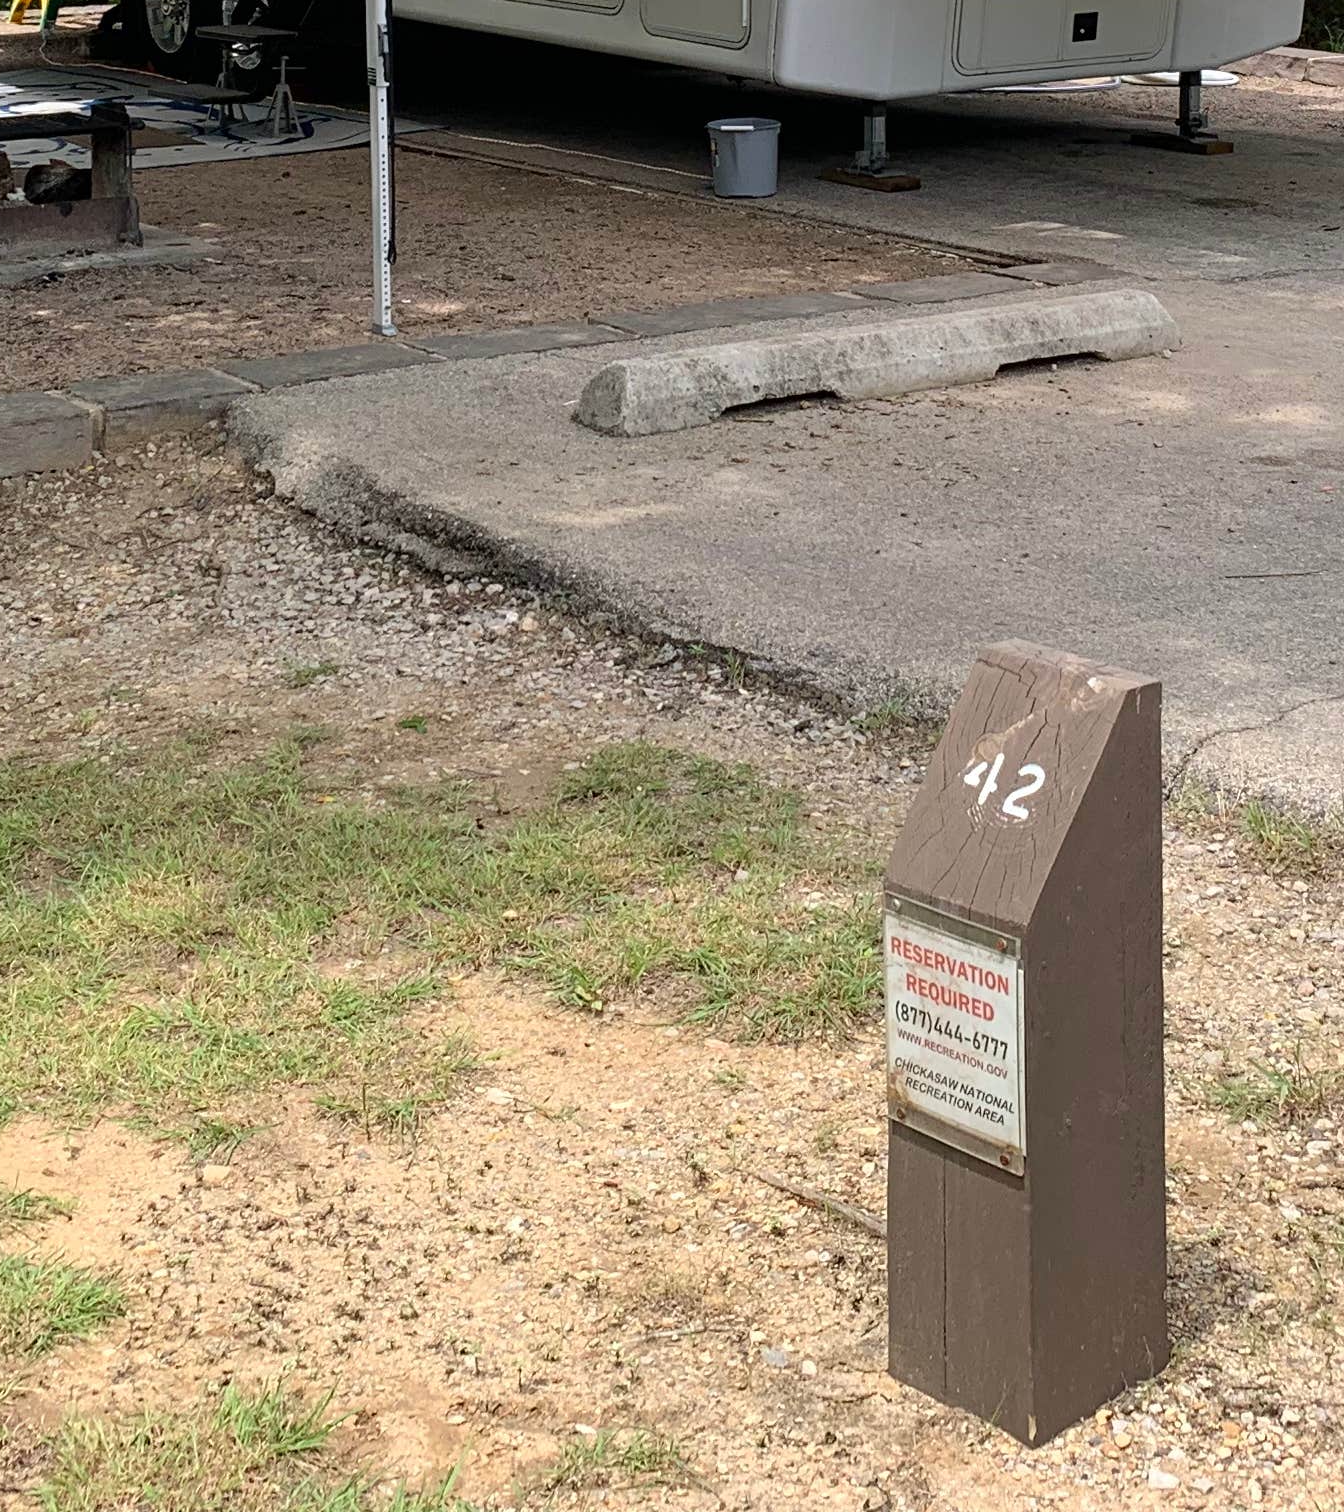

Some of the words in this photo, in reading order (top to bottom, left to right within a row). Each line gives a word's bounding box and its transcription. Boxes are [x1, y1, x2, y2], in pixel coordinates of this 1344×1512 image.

[963, 752, 1046, 820] 42
[890, 935, 1010, 996] RESERVATION
[906, 972, 995, 1022] REQUIRED
[895, 999, 1008, 1061] (877)444-6777
[897, 1027, 1008, 1079] WWW.RECREATION.GOV
[894, 1056, 959, 1091] CHICKASAW
[959, 1083, 1015, 1115] NATIONAL
[905, 1076, 973, 1113] RECREATION
[974, 1104, 1005, 1126] AREA
